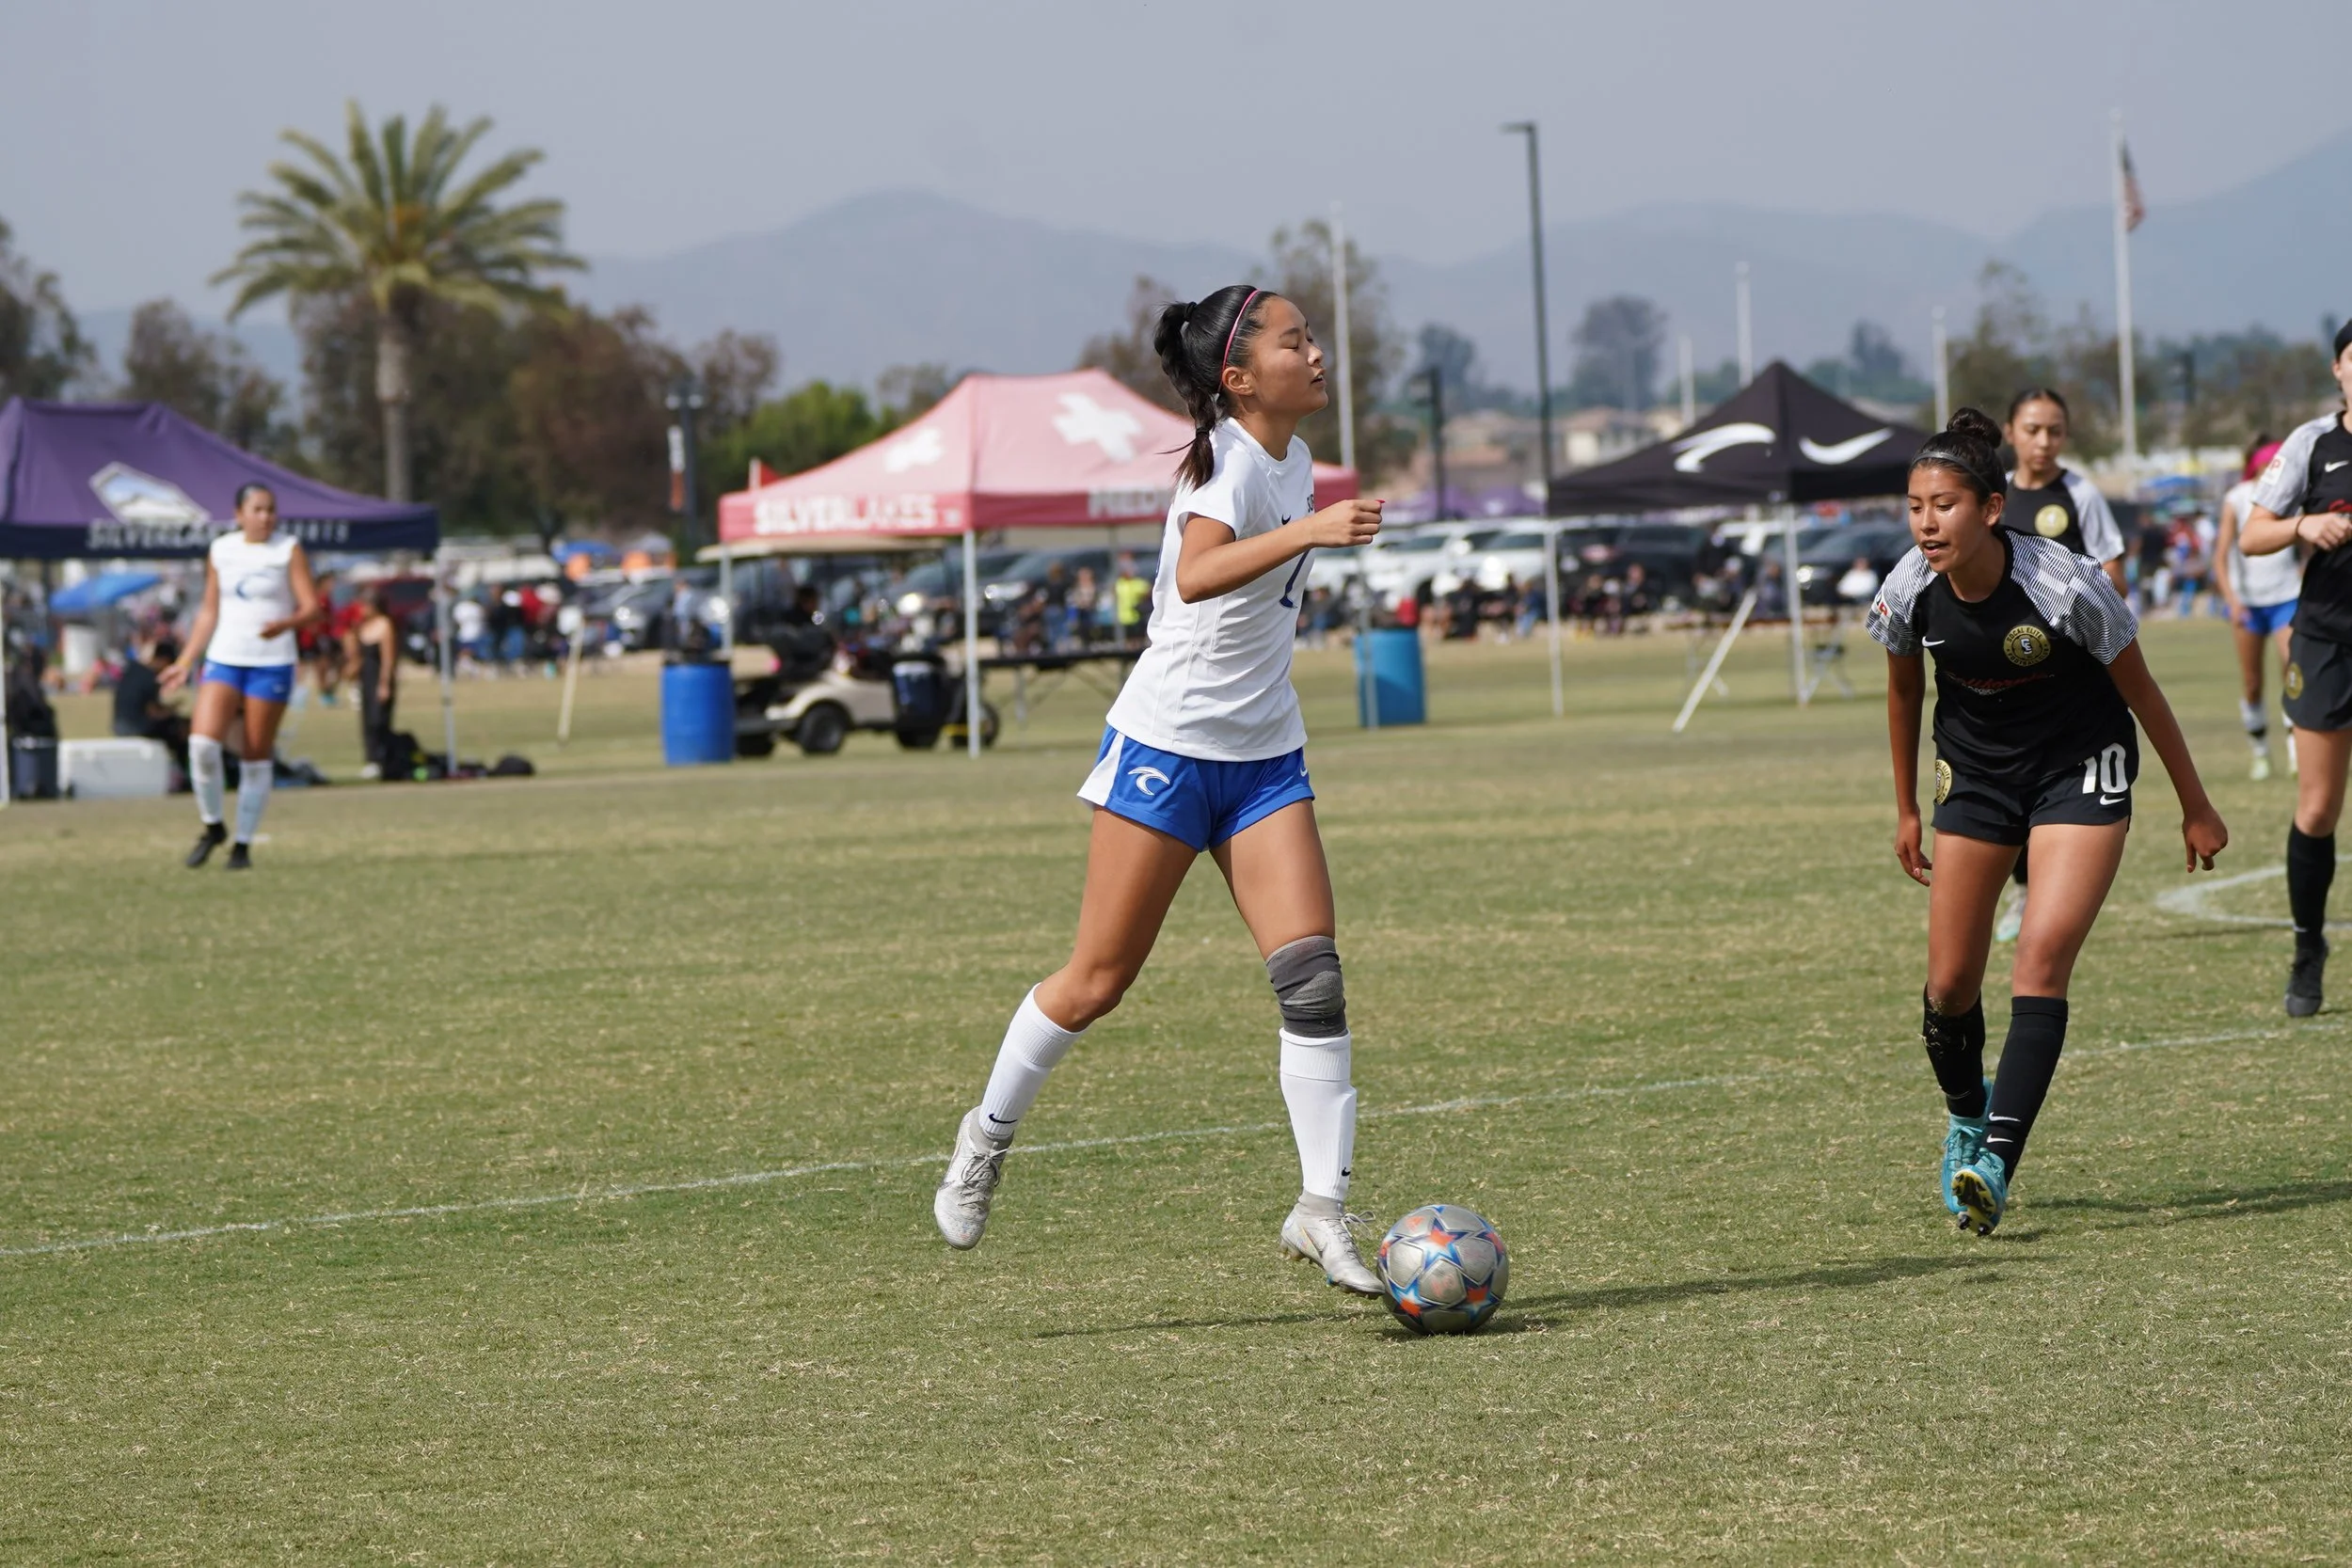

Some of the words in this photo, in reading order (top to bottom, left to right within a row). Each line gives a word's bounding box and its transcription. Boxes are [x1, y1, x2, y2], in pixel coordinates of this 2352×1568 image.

[755, 494, 938, 535] SILVERLAKES
[87, 517, 237, 550] SILVERLA
[2007, 626, 2025, 642] SOCAL
[2026, 626, 2043, 640] ELITE
[2082, 742, 2128, 794] 10
